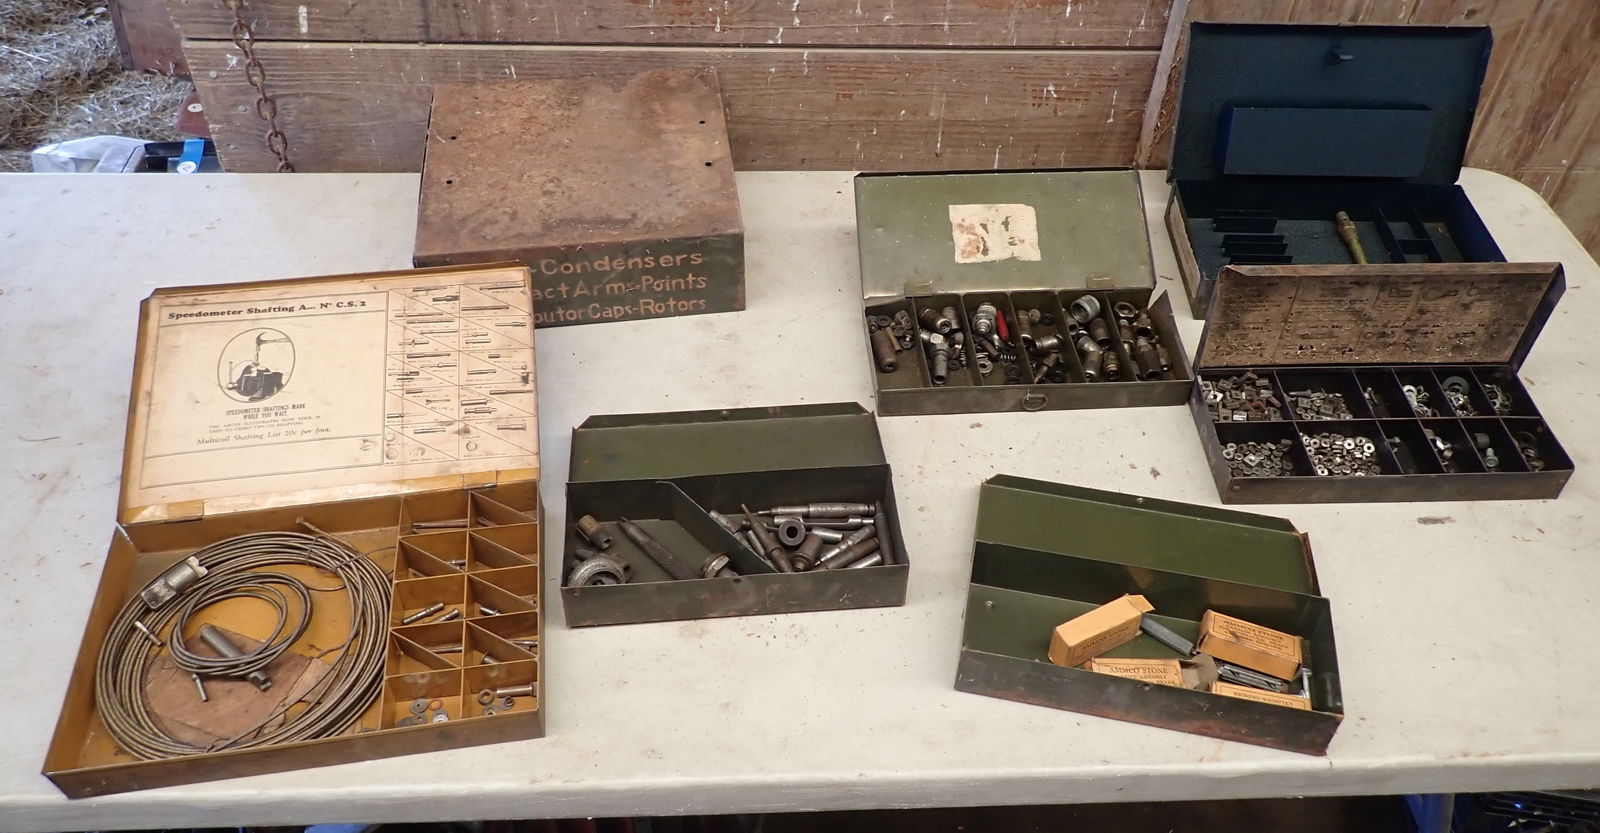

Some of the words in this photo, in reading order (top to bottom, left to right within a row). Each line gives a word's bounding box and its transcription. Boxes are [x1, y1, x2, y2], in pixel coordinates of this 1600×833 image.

[168, 309, 243, 320] Speedometer
[247, 305, 295, 315] Shafting
[225, 407, 261, 416] SPEEDOMETER
[263, 404, 290, 413] SHAFTINGS
[234, 432, 264, 441] Shafting
[300, 428, 312, 436] per
[1223, 620, 1256, 633] AMMCO
